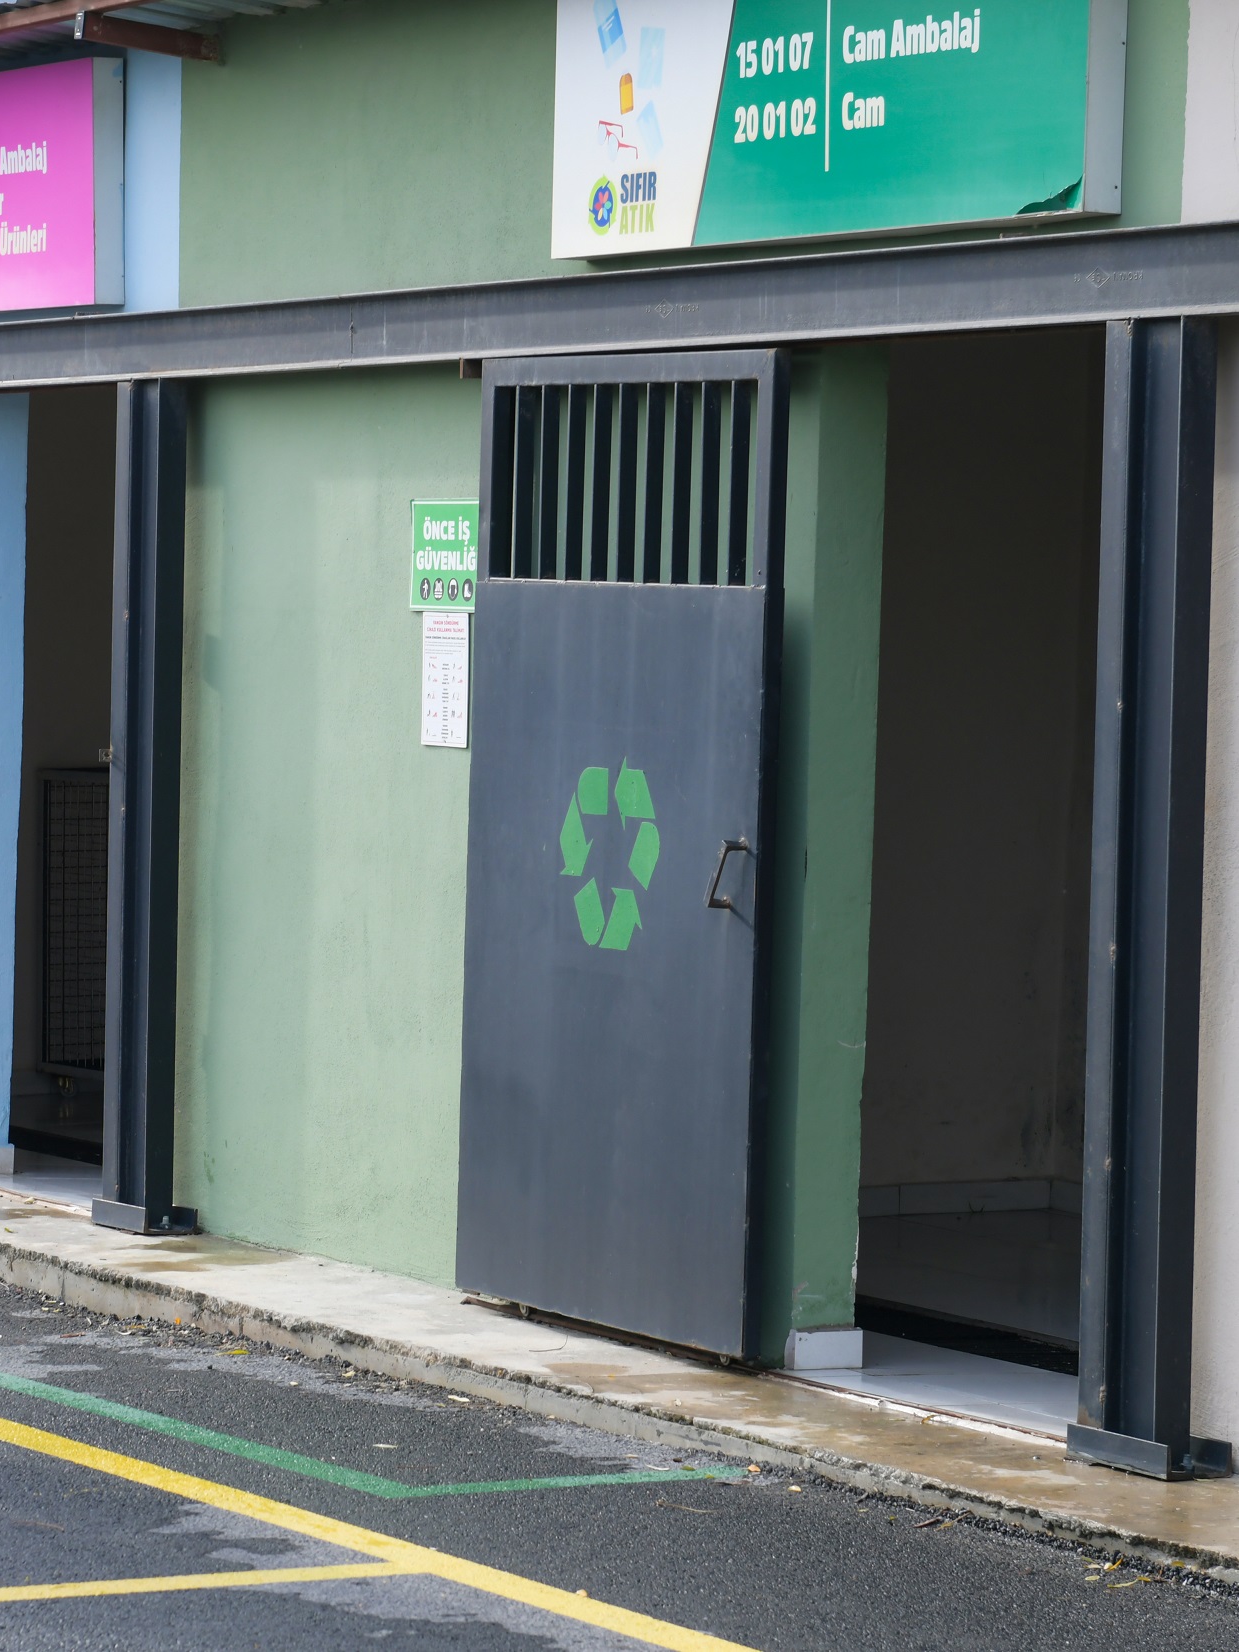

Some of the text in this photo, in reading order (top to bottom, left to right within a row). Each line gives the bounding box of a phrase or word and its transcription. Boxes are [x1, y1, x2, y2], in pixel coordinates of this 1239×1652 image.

[736, 8, 980, 78] 15 01 07 Cam Ambalaj
[734, 92, 884, 143] 20 01 02 Cam
[0, 141, 47, 175] Ambalaj
[620, 171, 656, 204] SIFIR
[619, 203, 655, 234] ATIK
[0, 221, 46, 256] Ürünleri
[423, 515, 470, 545] ÖNCE İŞ
[416, 546, 477, 571] GÜVENLİĞ
